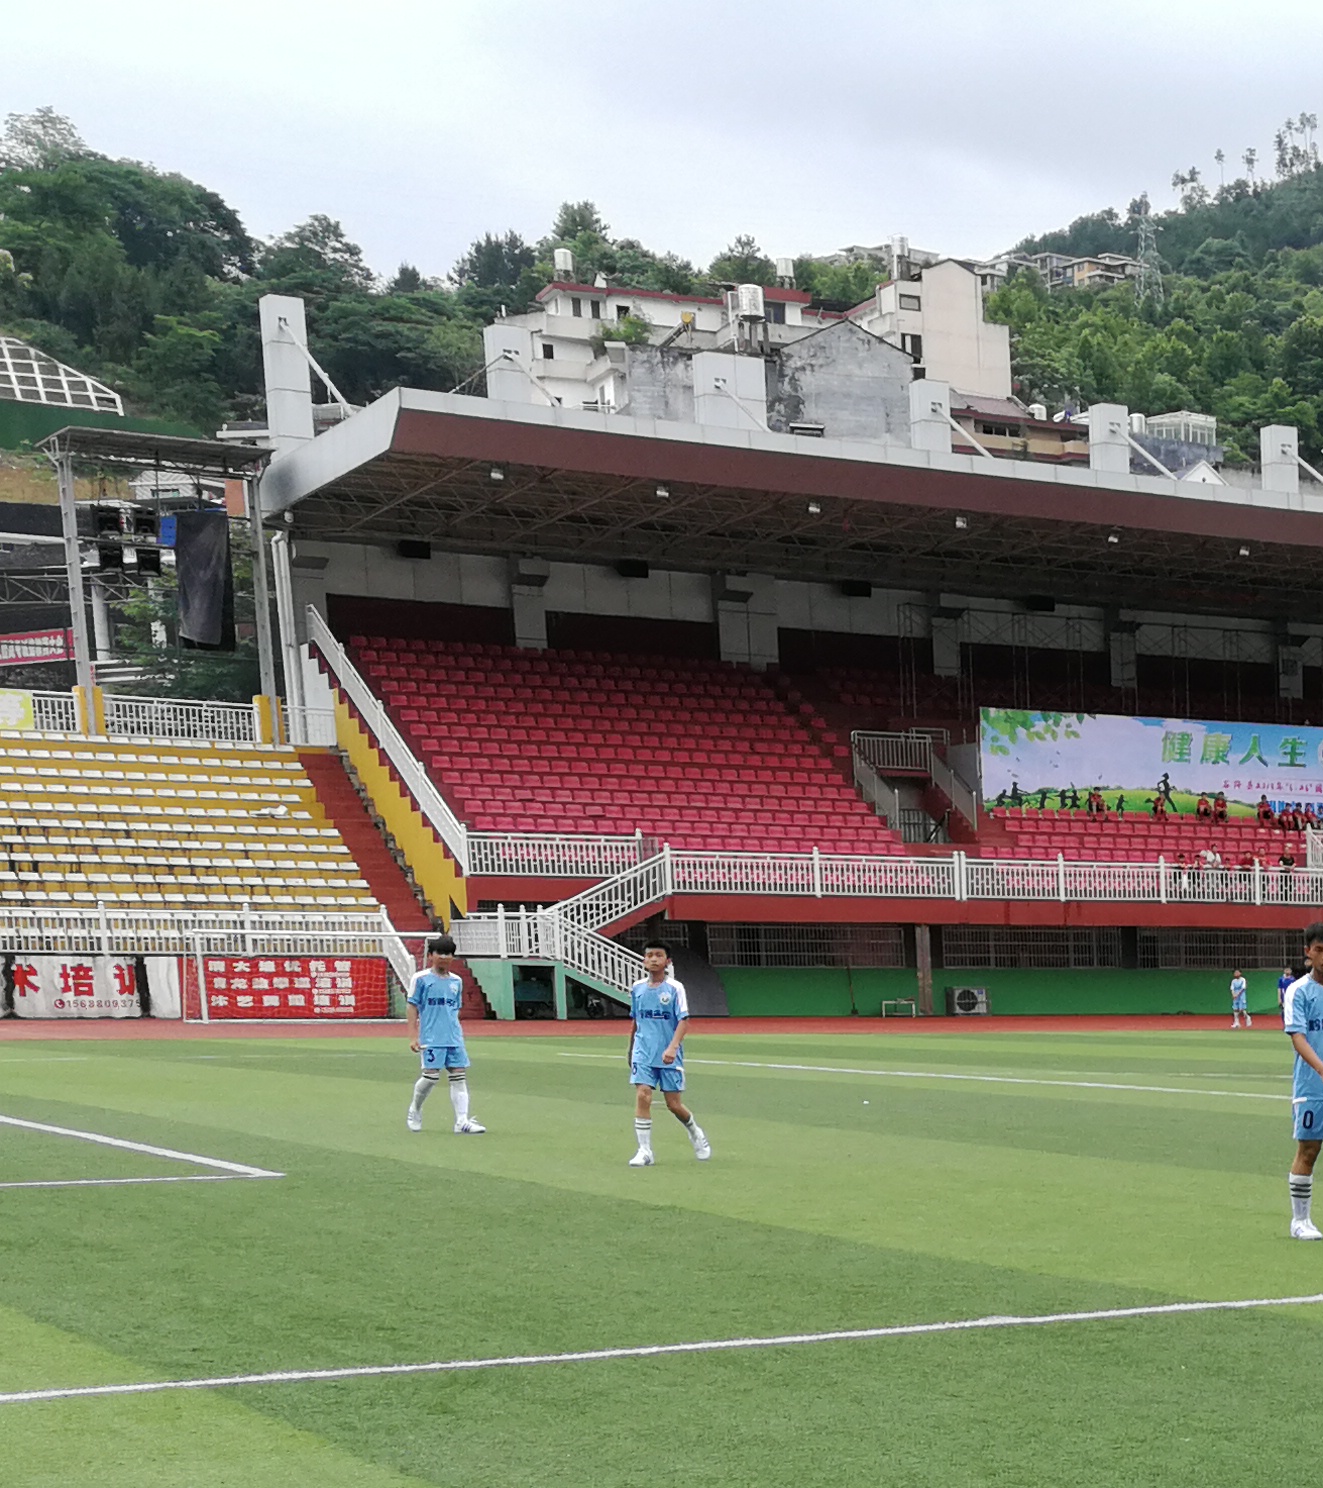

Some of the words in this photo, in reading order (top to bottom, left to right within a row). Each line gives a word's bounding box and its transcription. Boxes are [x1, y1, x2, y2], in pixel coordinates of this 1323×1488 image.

[1161, 729, 1308, 768] 健康人生
[427, 1049, 436, 1063] 3
[1303, 1110, 1313, 1129] 0
